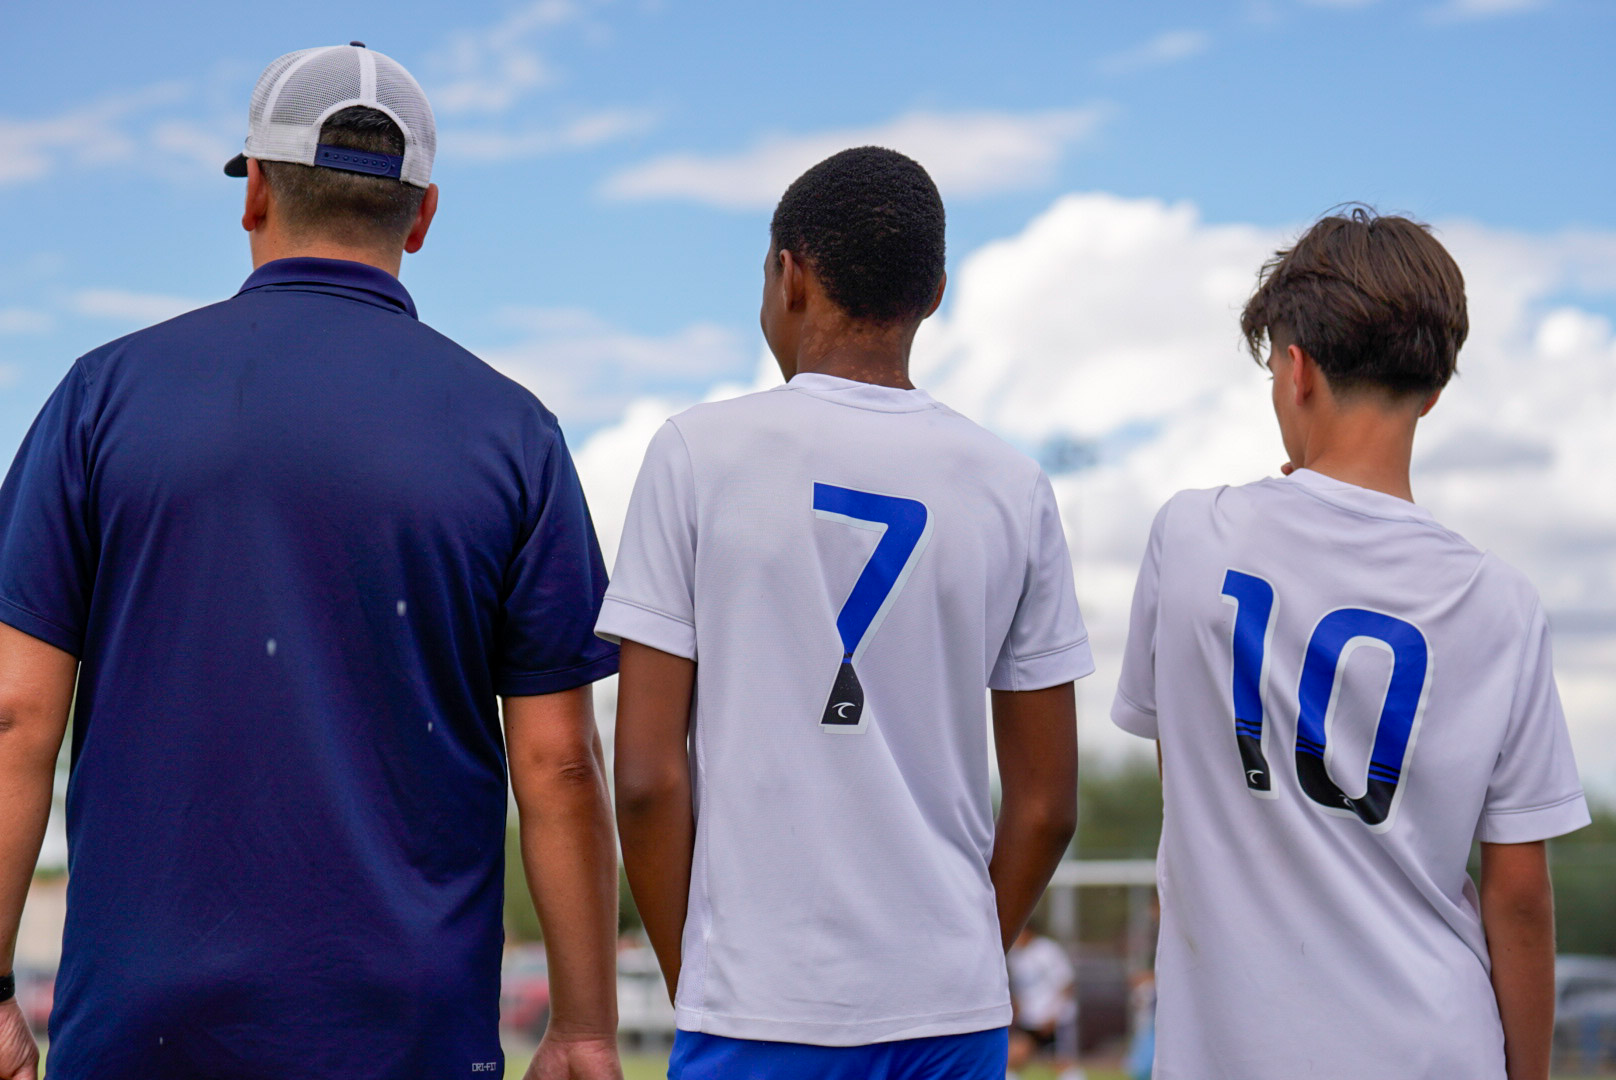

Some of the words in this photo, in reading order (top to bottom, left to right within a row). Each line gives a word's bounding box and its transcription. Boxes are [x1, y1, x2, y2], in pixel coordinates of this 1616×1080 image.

[812, 481, 932, 731] 7
[1220, 568, 1431, 831] 10
[471, 1061, 497, 1072] DRI-FIT
